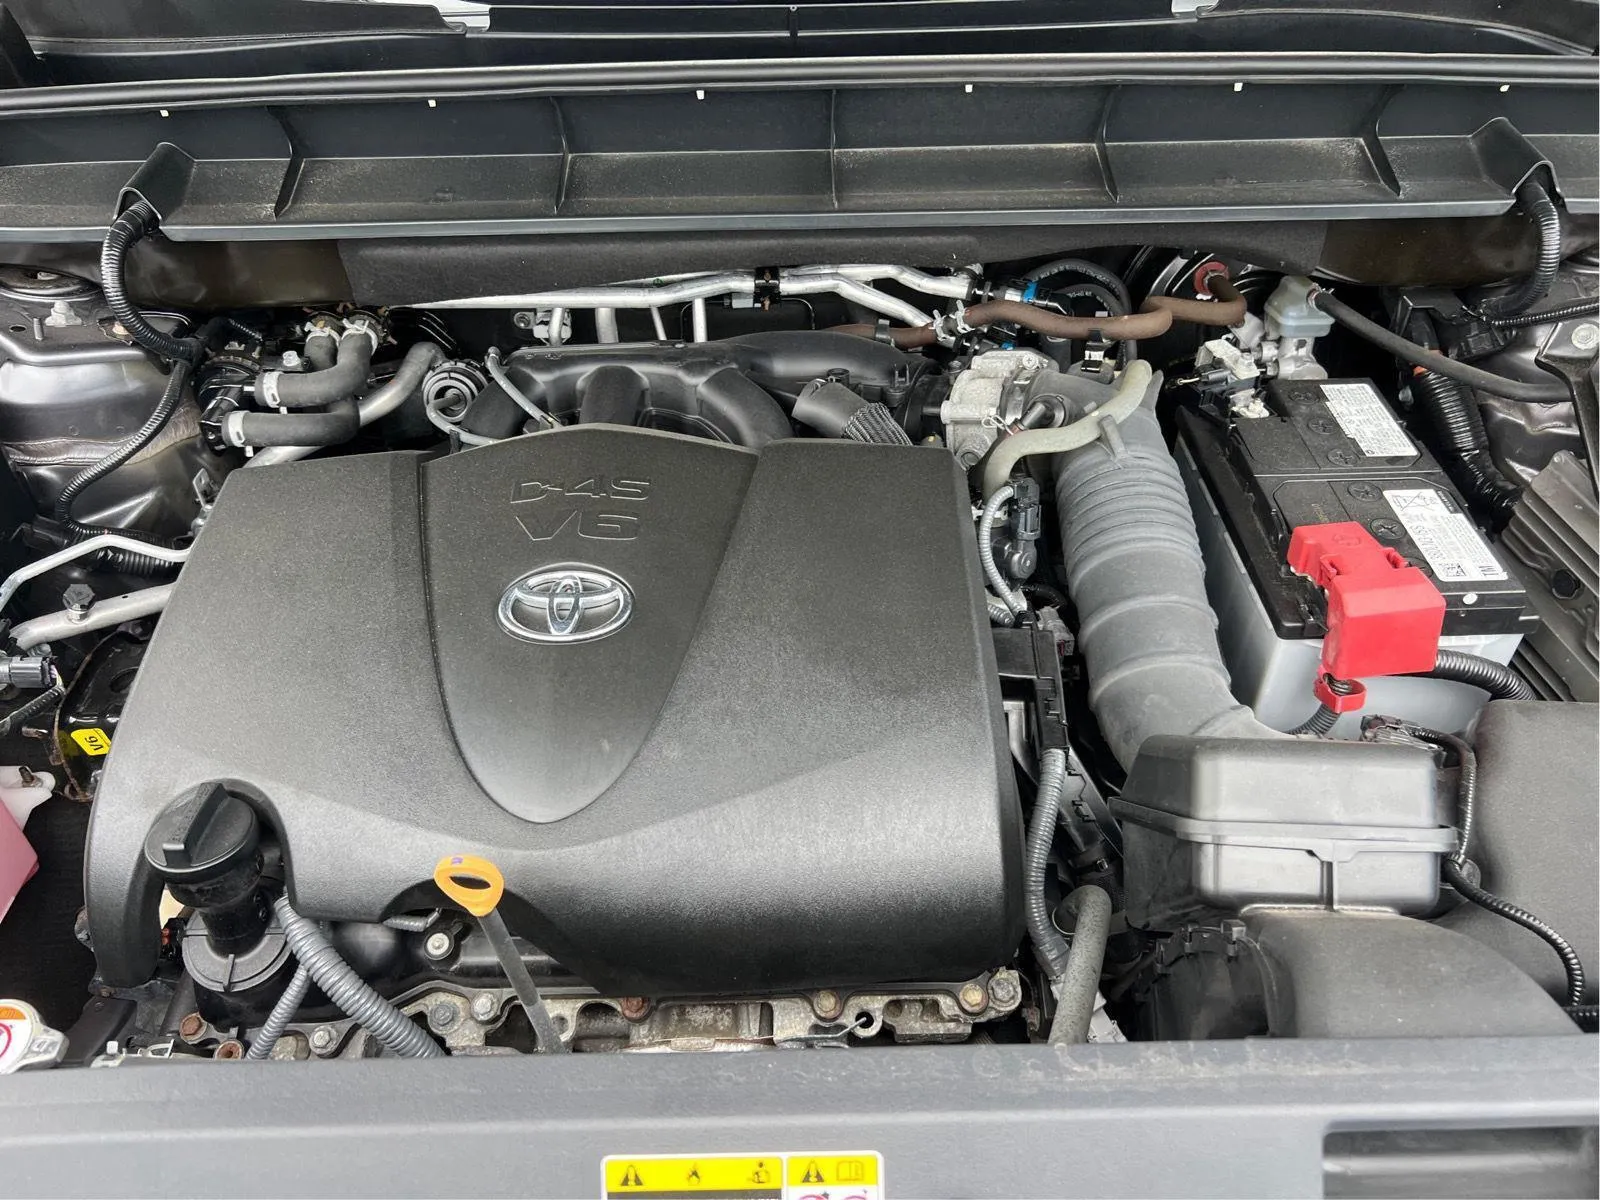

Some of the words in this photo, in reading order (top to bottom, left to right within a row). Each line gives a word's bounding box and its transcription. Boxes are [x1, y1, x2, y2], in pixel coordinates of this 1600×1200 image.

[509, 478, 651, 504] D-4S
[513, 508, 639, 541] V6
[84, 735, 104, 751] V6
